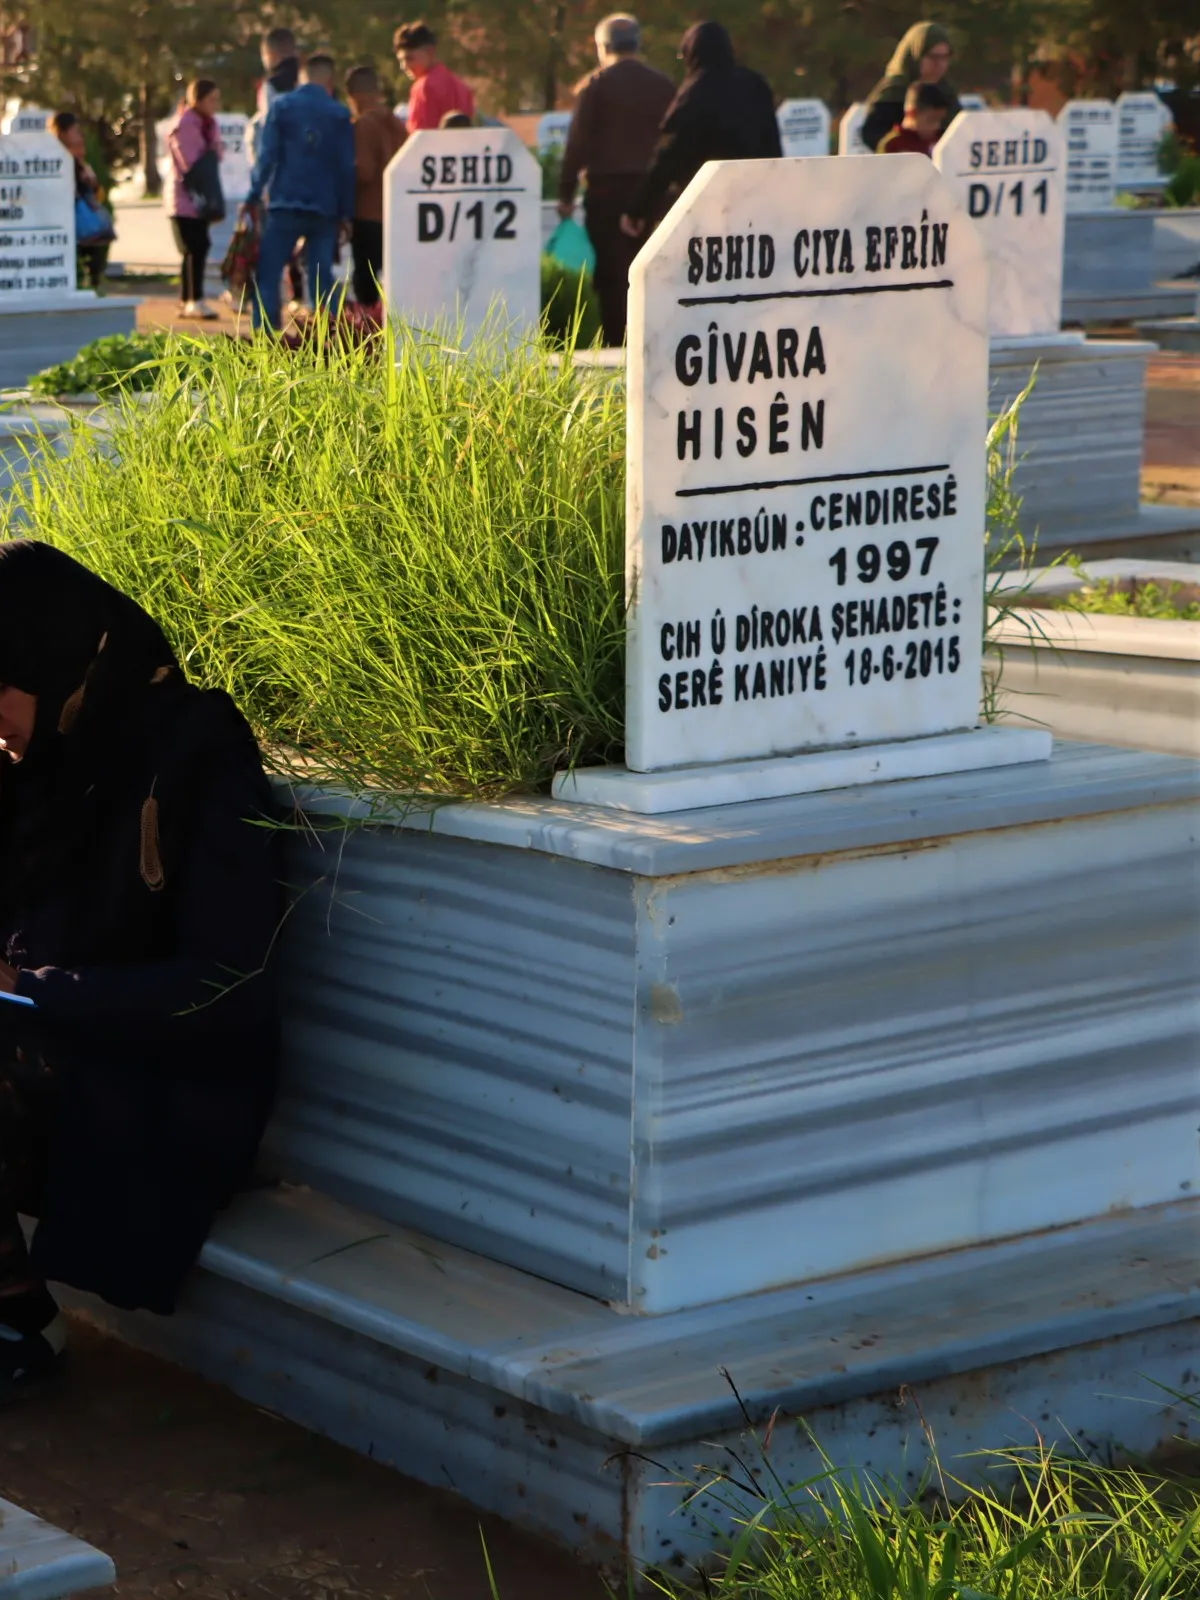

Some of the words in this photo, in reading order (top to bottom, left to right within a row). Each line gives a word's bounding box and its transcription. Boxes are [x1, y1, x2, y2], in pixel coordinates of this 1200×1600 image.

[418, 200, 517, 242] D/12
[968, 179, 1048, 219] D/11
[793, 228, 855, 279] CIYA
[675, 321, 826, 387] GÎVARA
[677, 391, 825, 460] HISÊN
[828, 537, 940, 586] 1997
[660, 619, 701, 662] CIH
[736, 604, 823, 652] DÎROKA
[658, 658, 724, 713] SERÊ
